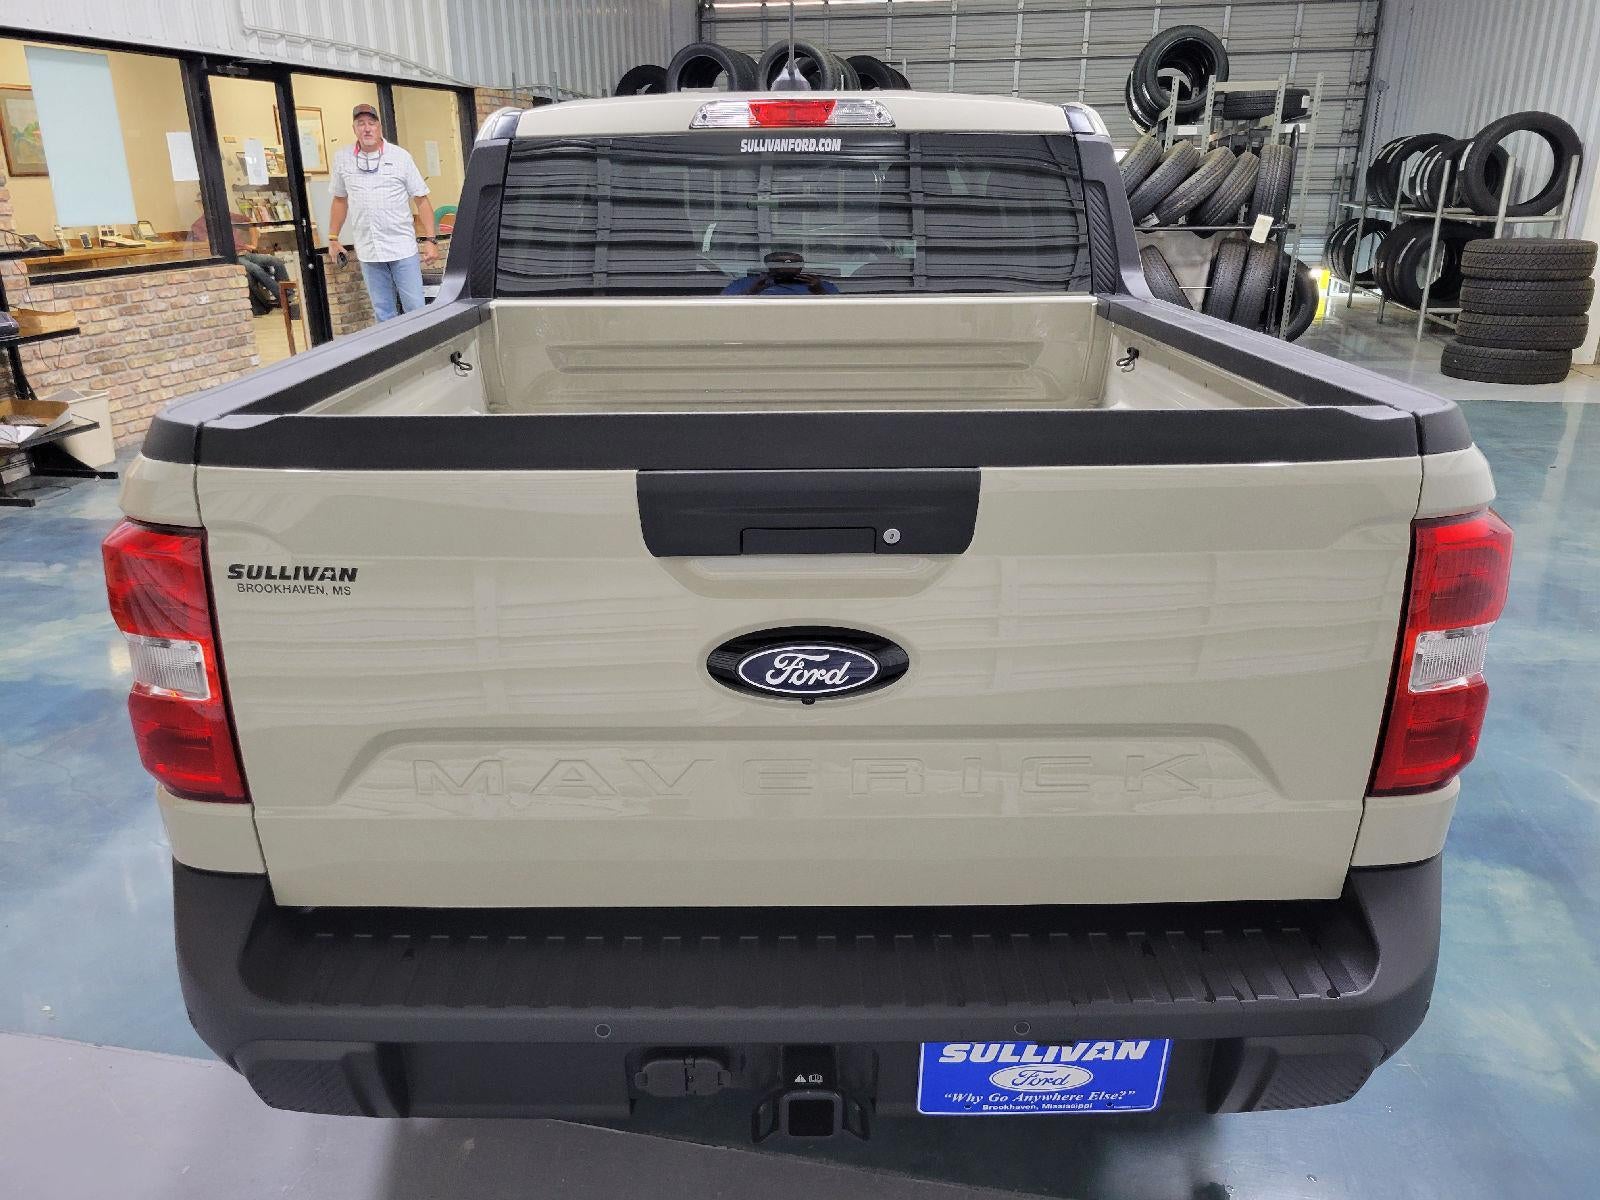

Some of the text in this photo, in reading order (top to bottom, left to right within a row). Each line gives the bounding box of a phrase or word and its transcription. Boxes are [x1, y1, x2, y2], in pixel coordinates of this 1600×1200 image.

[740, 138, 842, 153] SULLIVANFORD.COM
[227, 563, 358, 582] SULLIVAN
[237, 583, 351, 596] BROOKHAVEN, MS
[765, 652, 852, 686] Ford
[412, 754, 1205, 797] MAVERICK
[938, 1040, 1151, 1064] SULLIVAN
[1011, 1069, 1069, 1087] Ford
[982, 1102, 1093, 1111] Brookhaven, Mississippi
[988, 1092, 1009, 1103] Go
[1012, 1092, 1084, 1105] Anywhere
